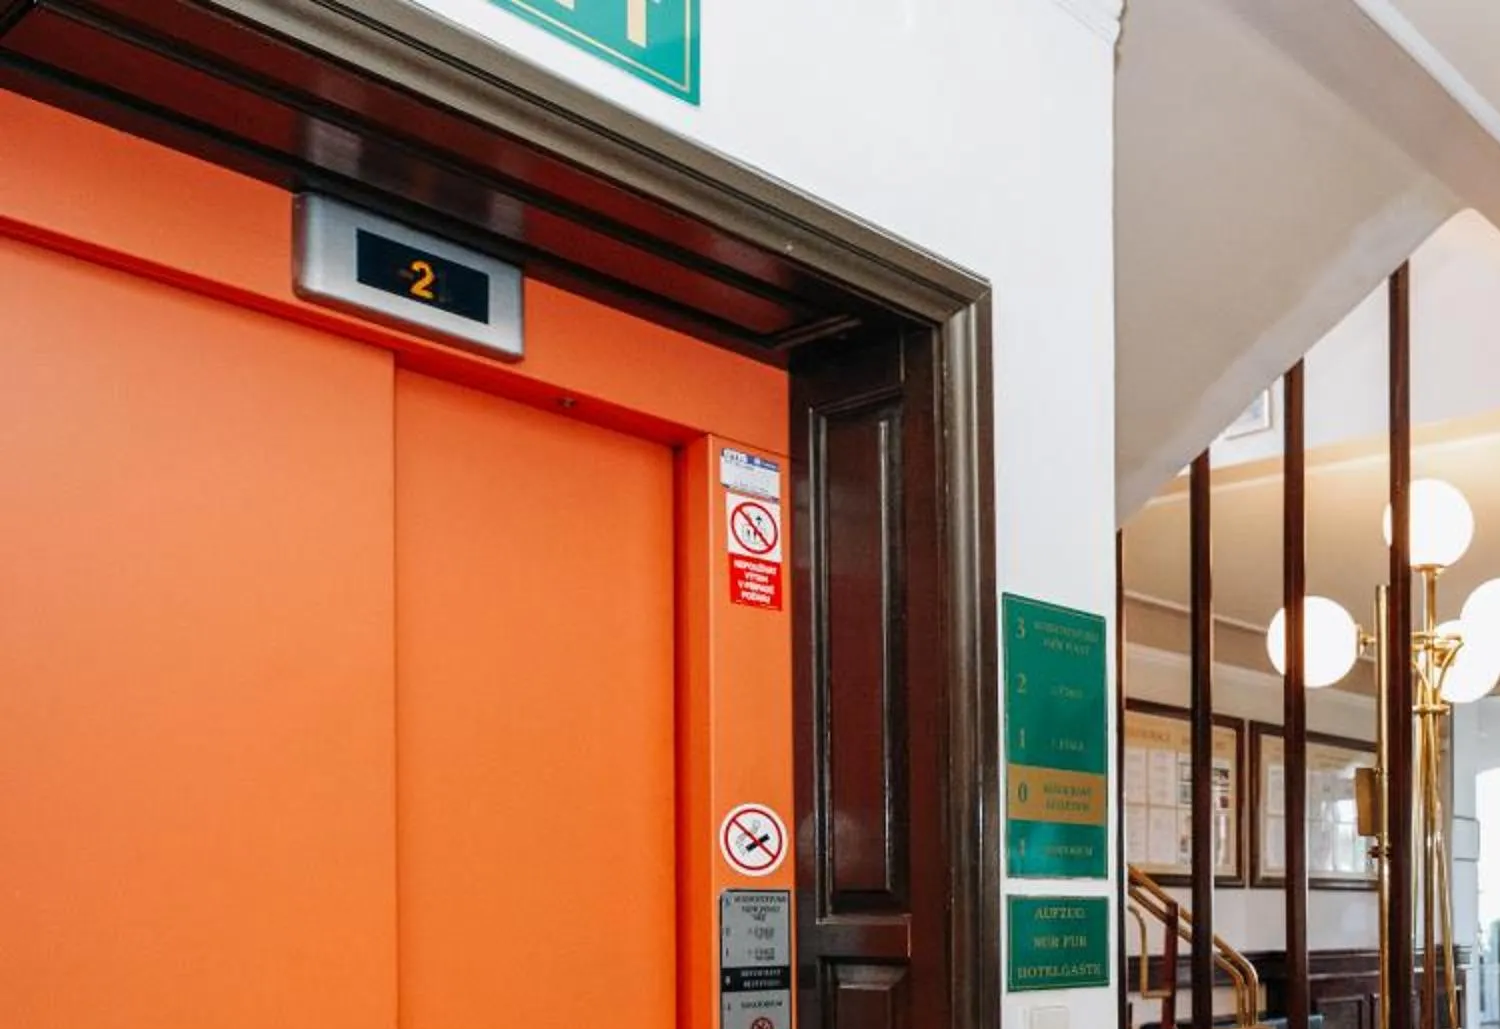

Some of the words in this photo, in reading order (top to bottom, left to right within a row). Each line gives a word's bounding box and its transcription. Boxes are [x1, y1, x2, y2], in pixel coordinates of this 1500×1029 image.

[409, 260, 434, 299] 2
[1015, 616, 1026, 638] 3
[1015, 672, 1027, 693] 2
[1018, 728, 1026, 749] 1
[1017, 781, 1028, 803] 0
